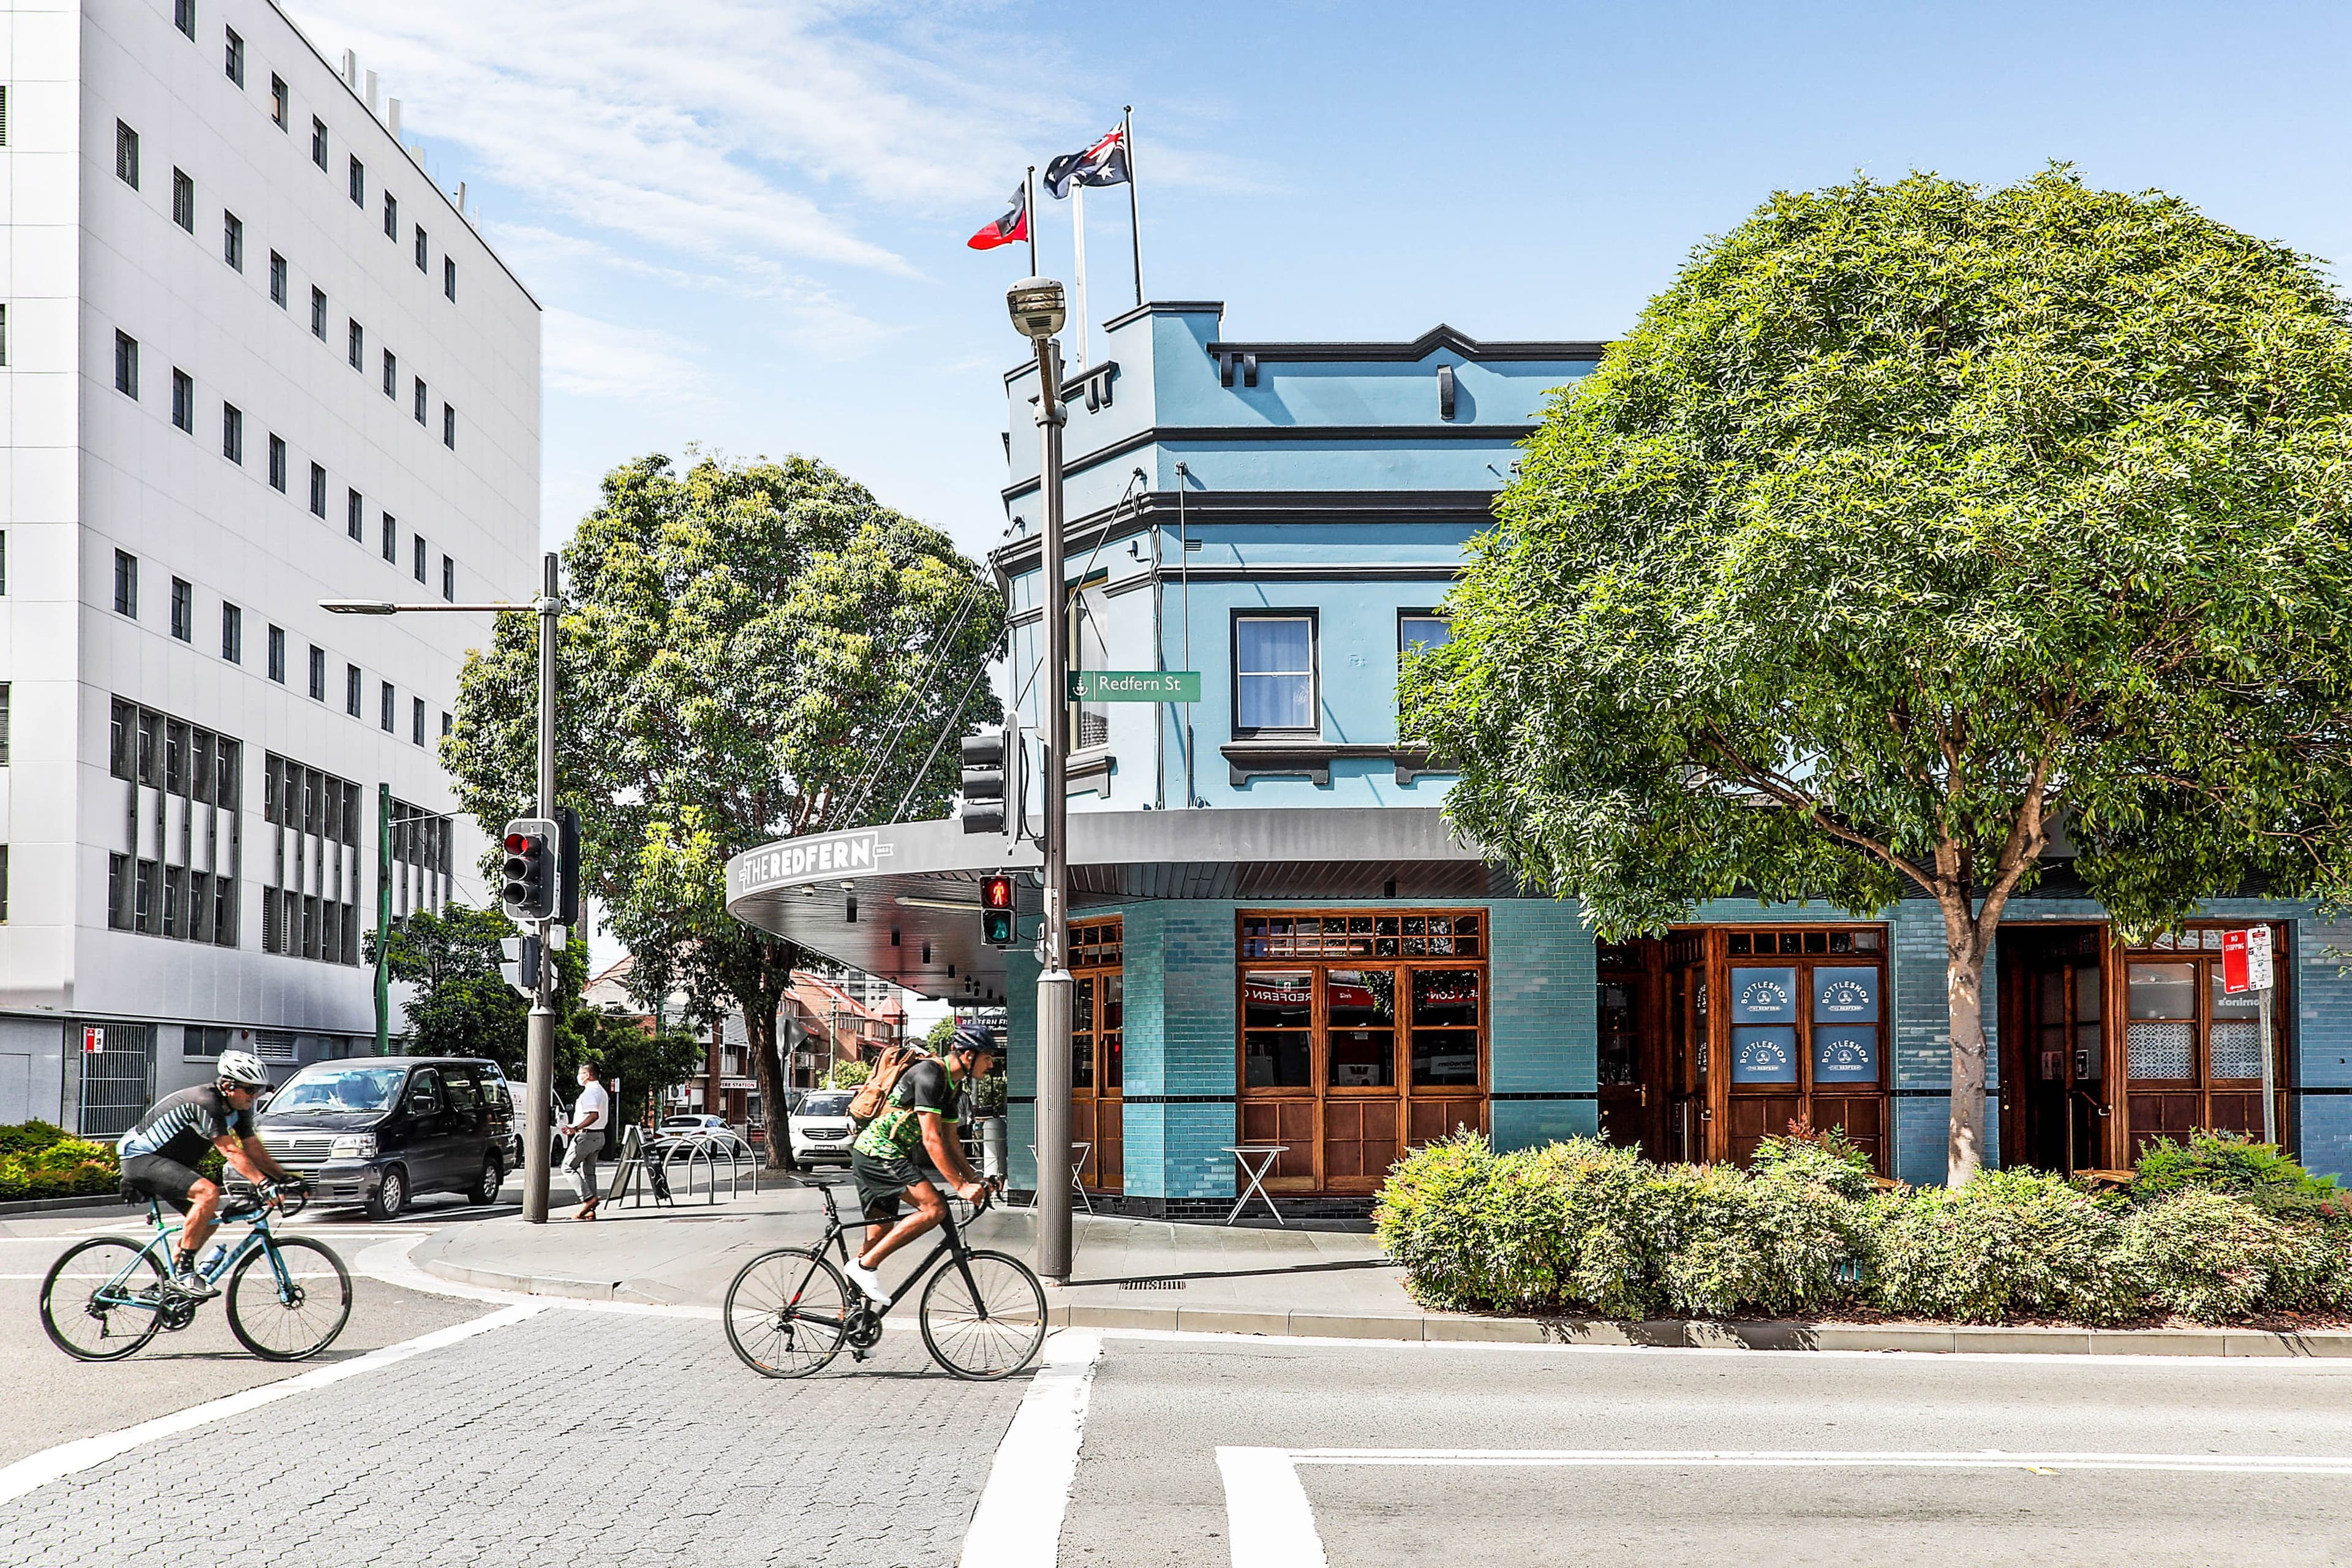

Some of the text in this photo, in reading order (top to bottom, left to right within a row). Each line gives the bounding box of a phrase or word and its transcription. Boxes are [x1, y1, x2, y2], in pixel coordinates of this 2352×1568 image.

[1099, 676, 1181, 690] Redfern St
[746, 839, 869, 884] THE REDFERN
[1741, 981, 1788, 1004] BOTTLESHOP
[1822, 981, 1869, 1004] BOTTLESHOP
[1740, 1041, 1787, 1064] BOTTLESHOP
[1822, 1040, 1869, 1063] BOTTLESHOP
